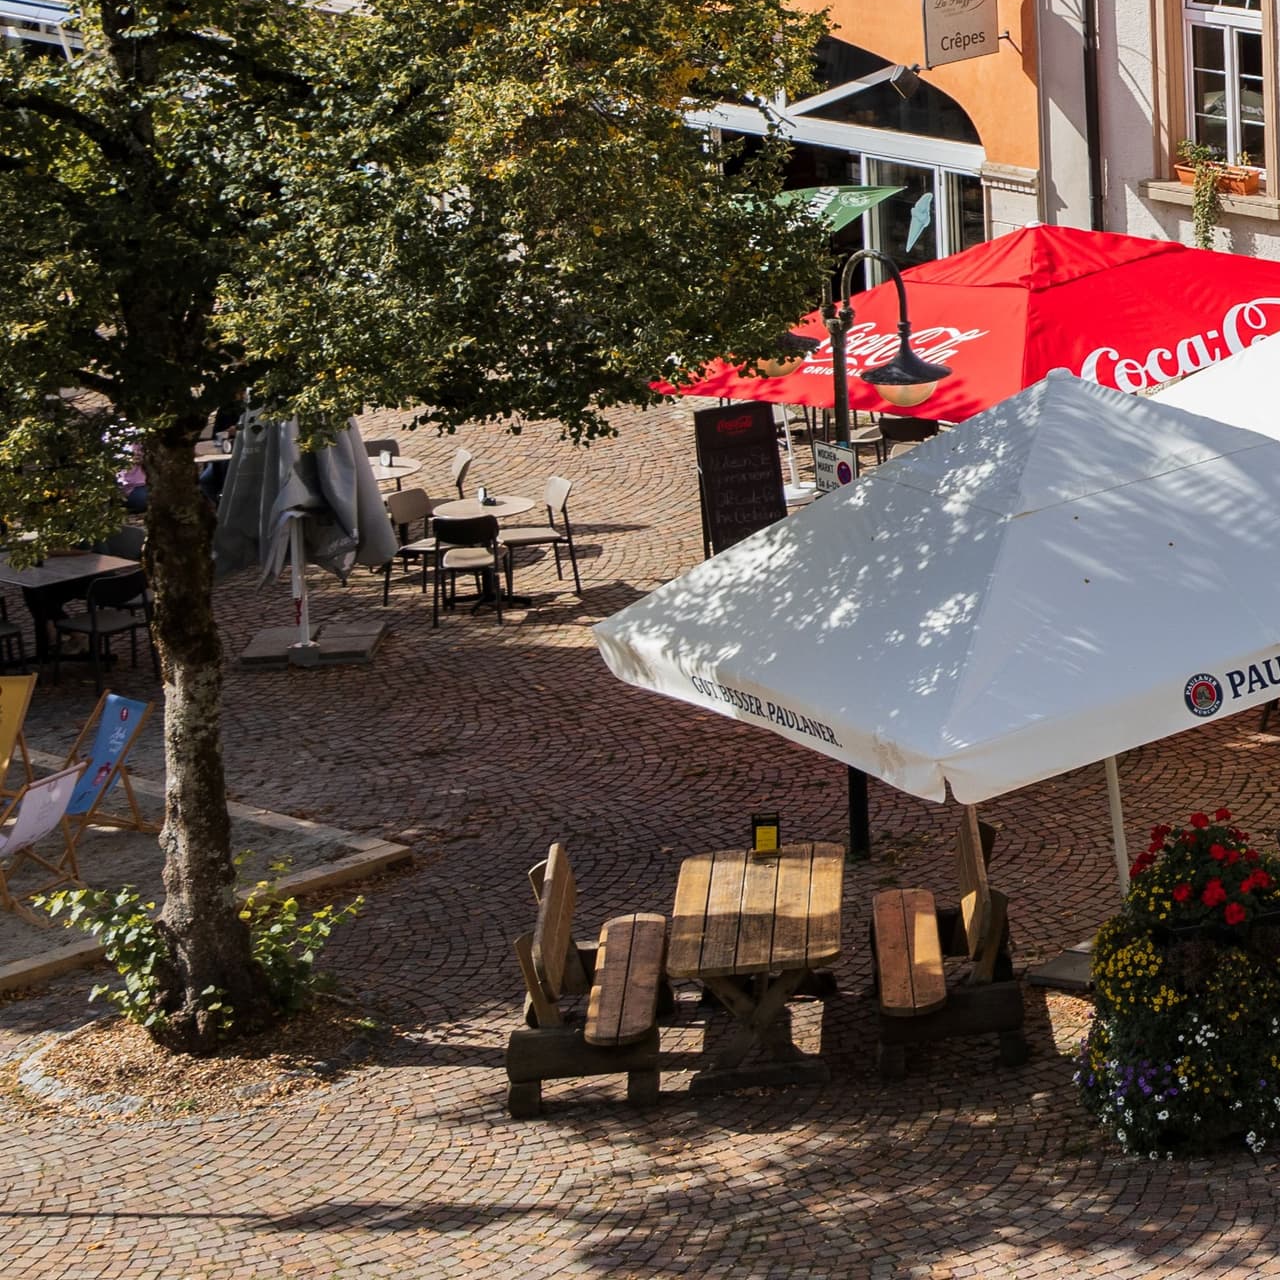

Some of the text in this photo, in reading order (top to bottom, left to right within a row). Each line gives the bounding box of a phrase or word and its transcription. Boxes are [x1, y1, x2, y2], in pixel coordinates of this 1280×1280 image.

[940, 31, 986, 51] Crêpes
[802, 365, 864, 377] ORIGAL
[1185, 673, 1218, 696] PAULANER
[767, 701, 843, 748] PAULANER.
